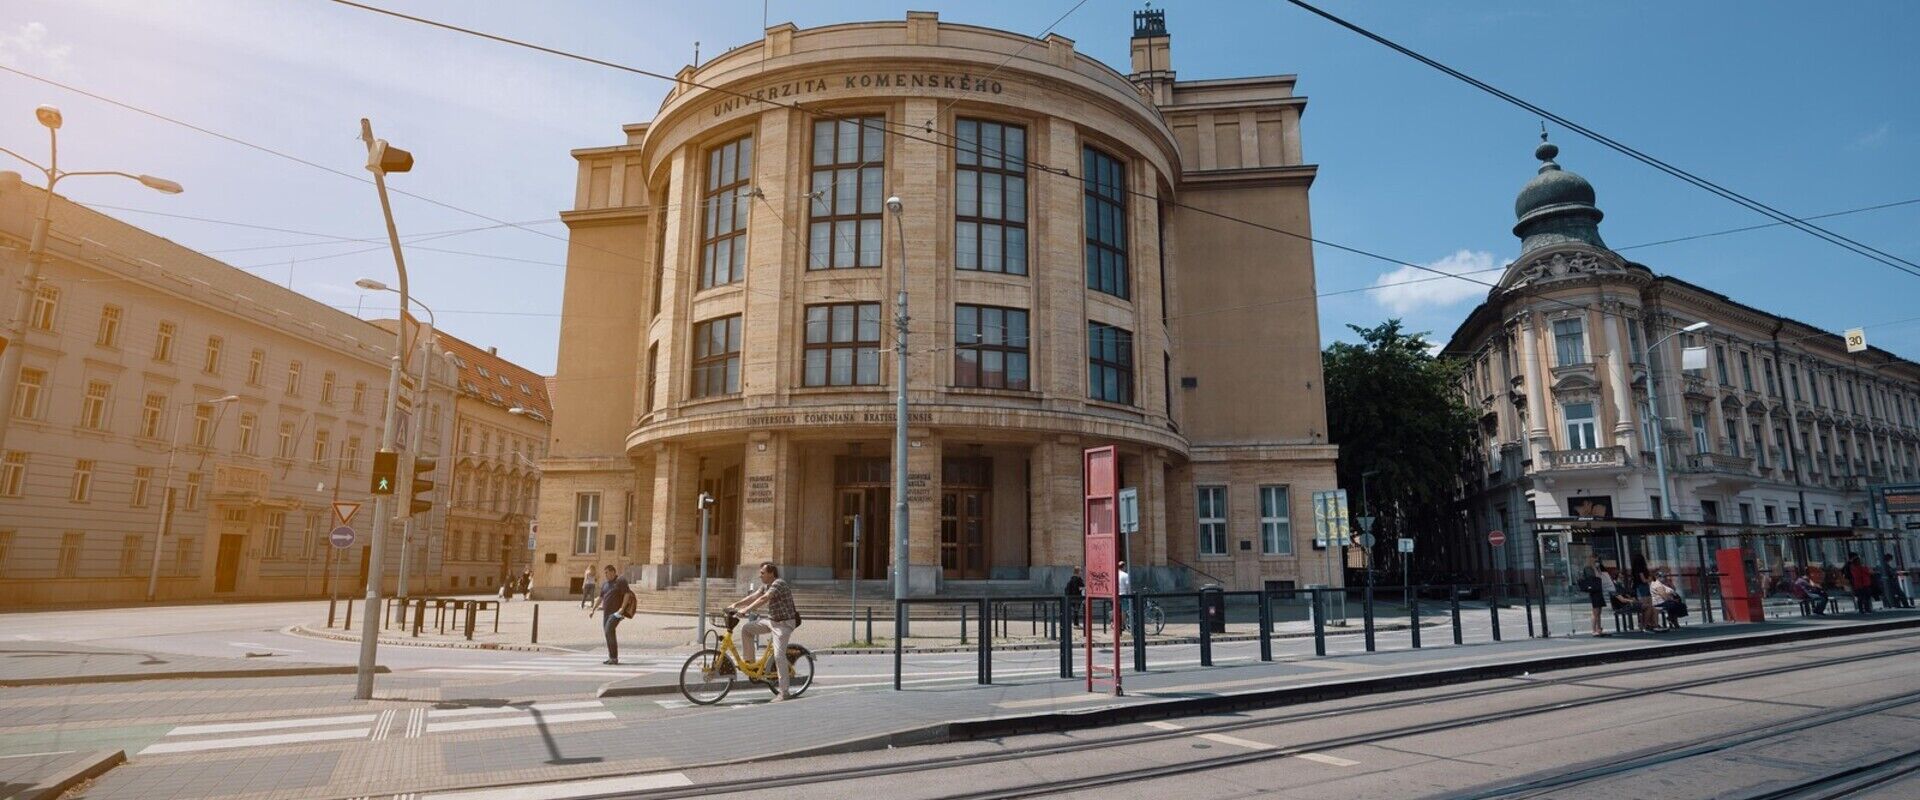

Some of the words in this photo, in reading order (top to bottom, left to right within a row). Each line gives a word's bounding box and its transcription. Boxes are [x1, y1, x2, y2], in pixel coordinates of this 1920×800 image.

[713, 78, 827, 117] UNIVERZITA
[845, 73, 1003, 95] KOMENSKÉHO
[1848, 335, 1862, 346] 30
[747, 415, 796, 426] UNIVERSITAS
[804, 413, 855, 424] COMENIANA
[864, 413, 933, 422] BRATISLENSIS
